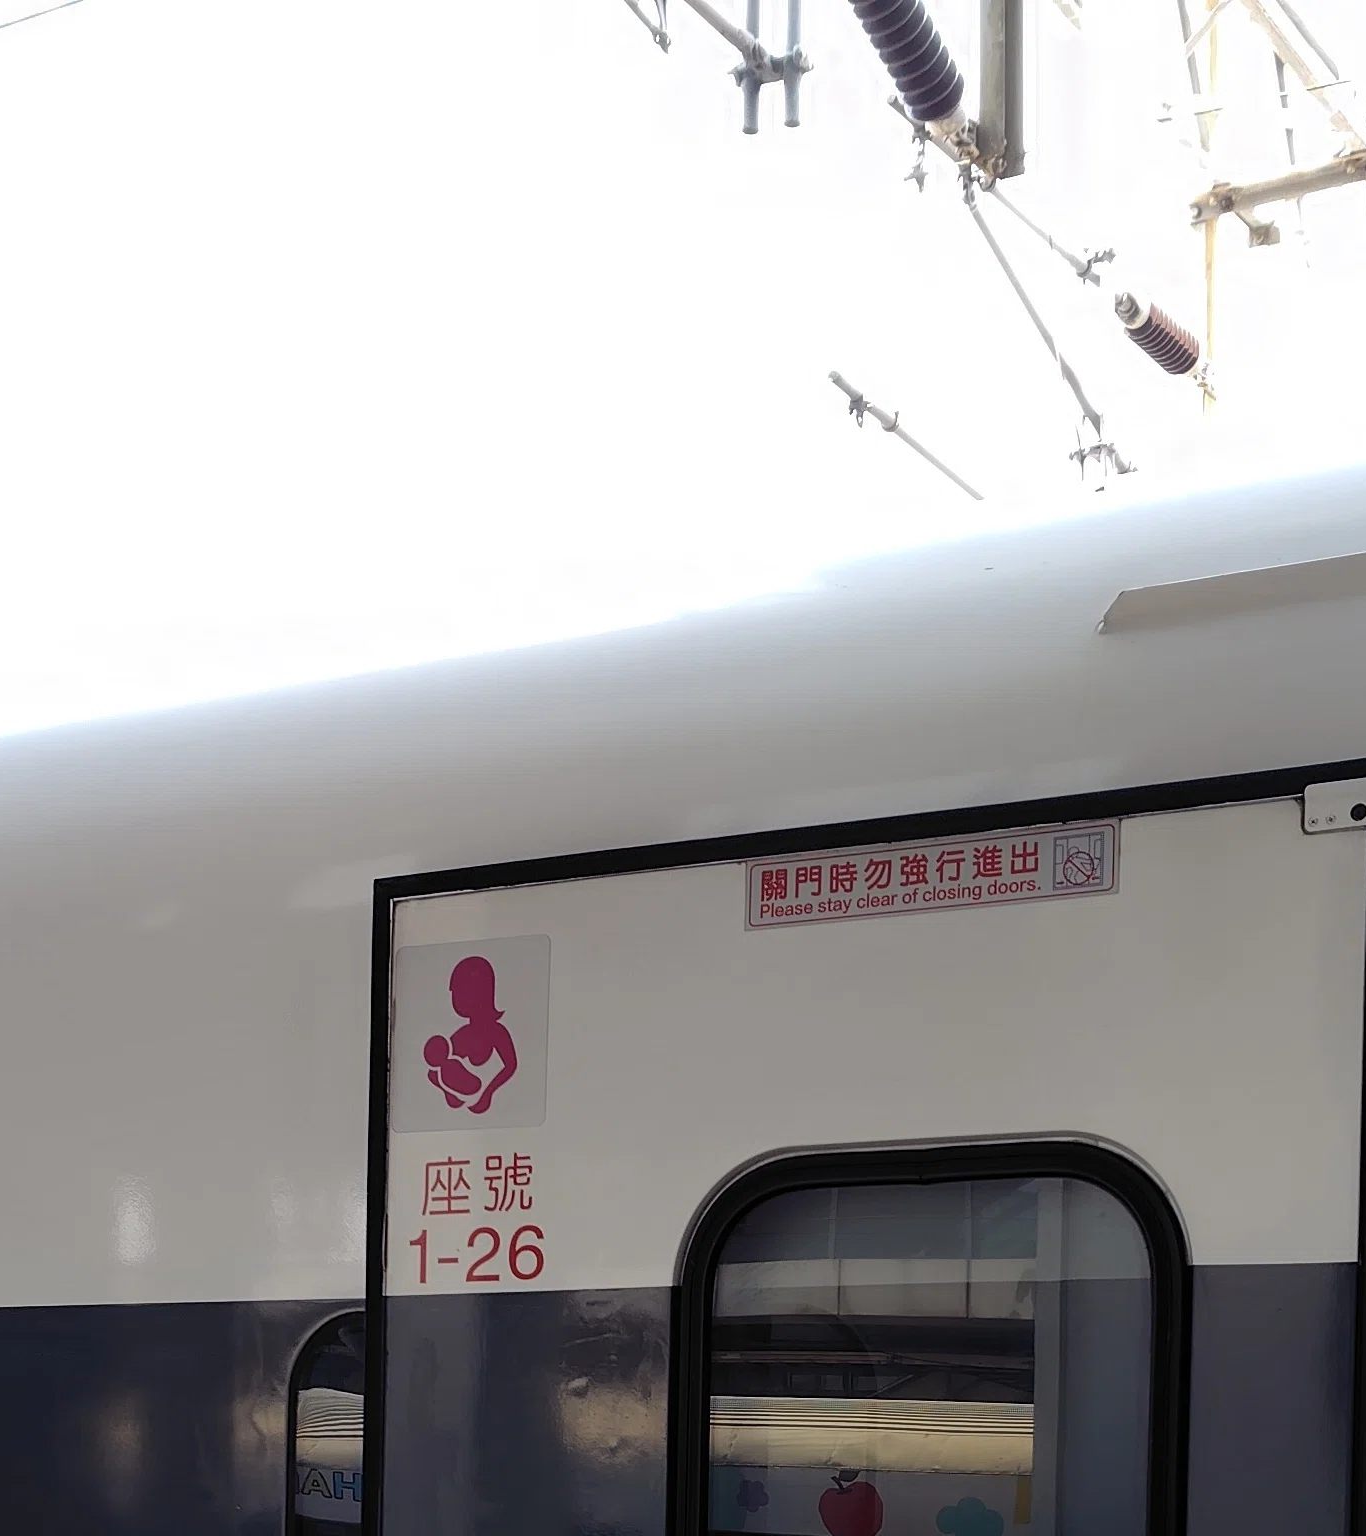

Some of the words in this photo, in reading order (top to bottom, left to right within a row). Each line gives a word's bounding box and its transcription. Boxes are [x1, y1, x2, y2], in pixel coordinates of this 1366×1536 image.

[759, 840, 1041, 902] 關門時勿強行進出
[759, 899, 814, 920] Please
[817, 896, 851, 916] stay
[856, 889, 896, 909] clear
[901, 886, 920, 906] of
[922, 880, 983, 907] closing
[986, 875, 1042, 896] doors.
[421, 1152, 534, 1217] 座號
[409, 1224, 545, 1284] 1-26
